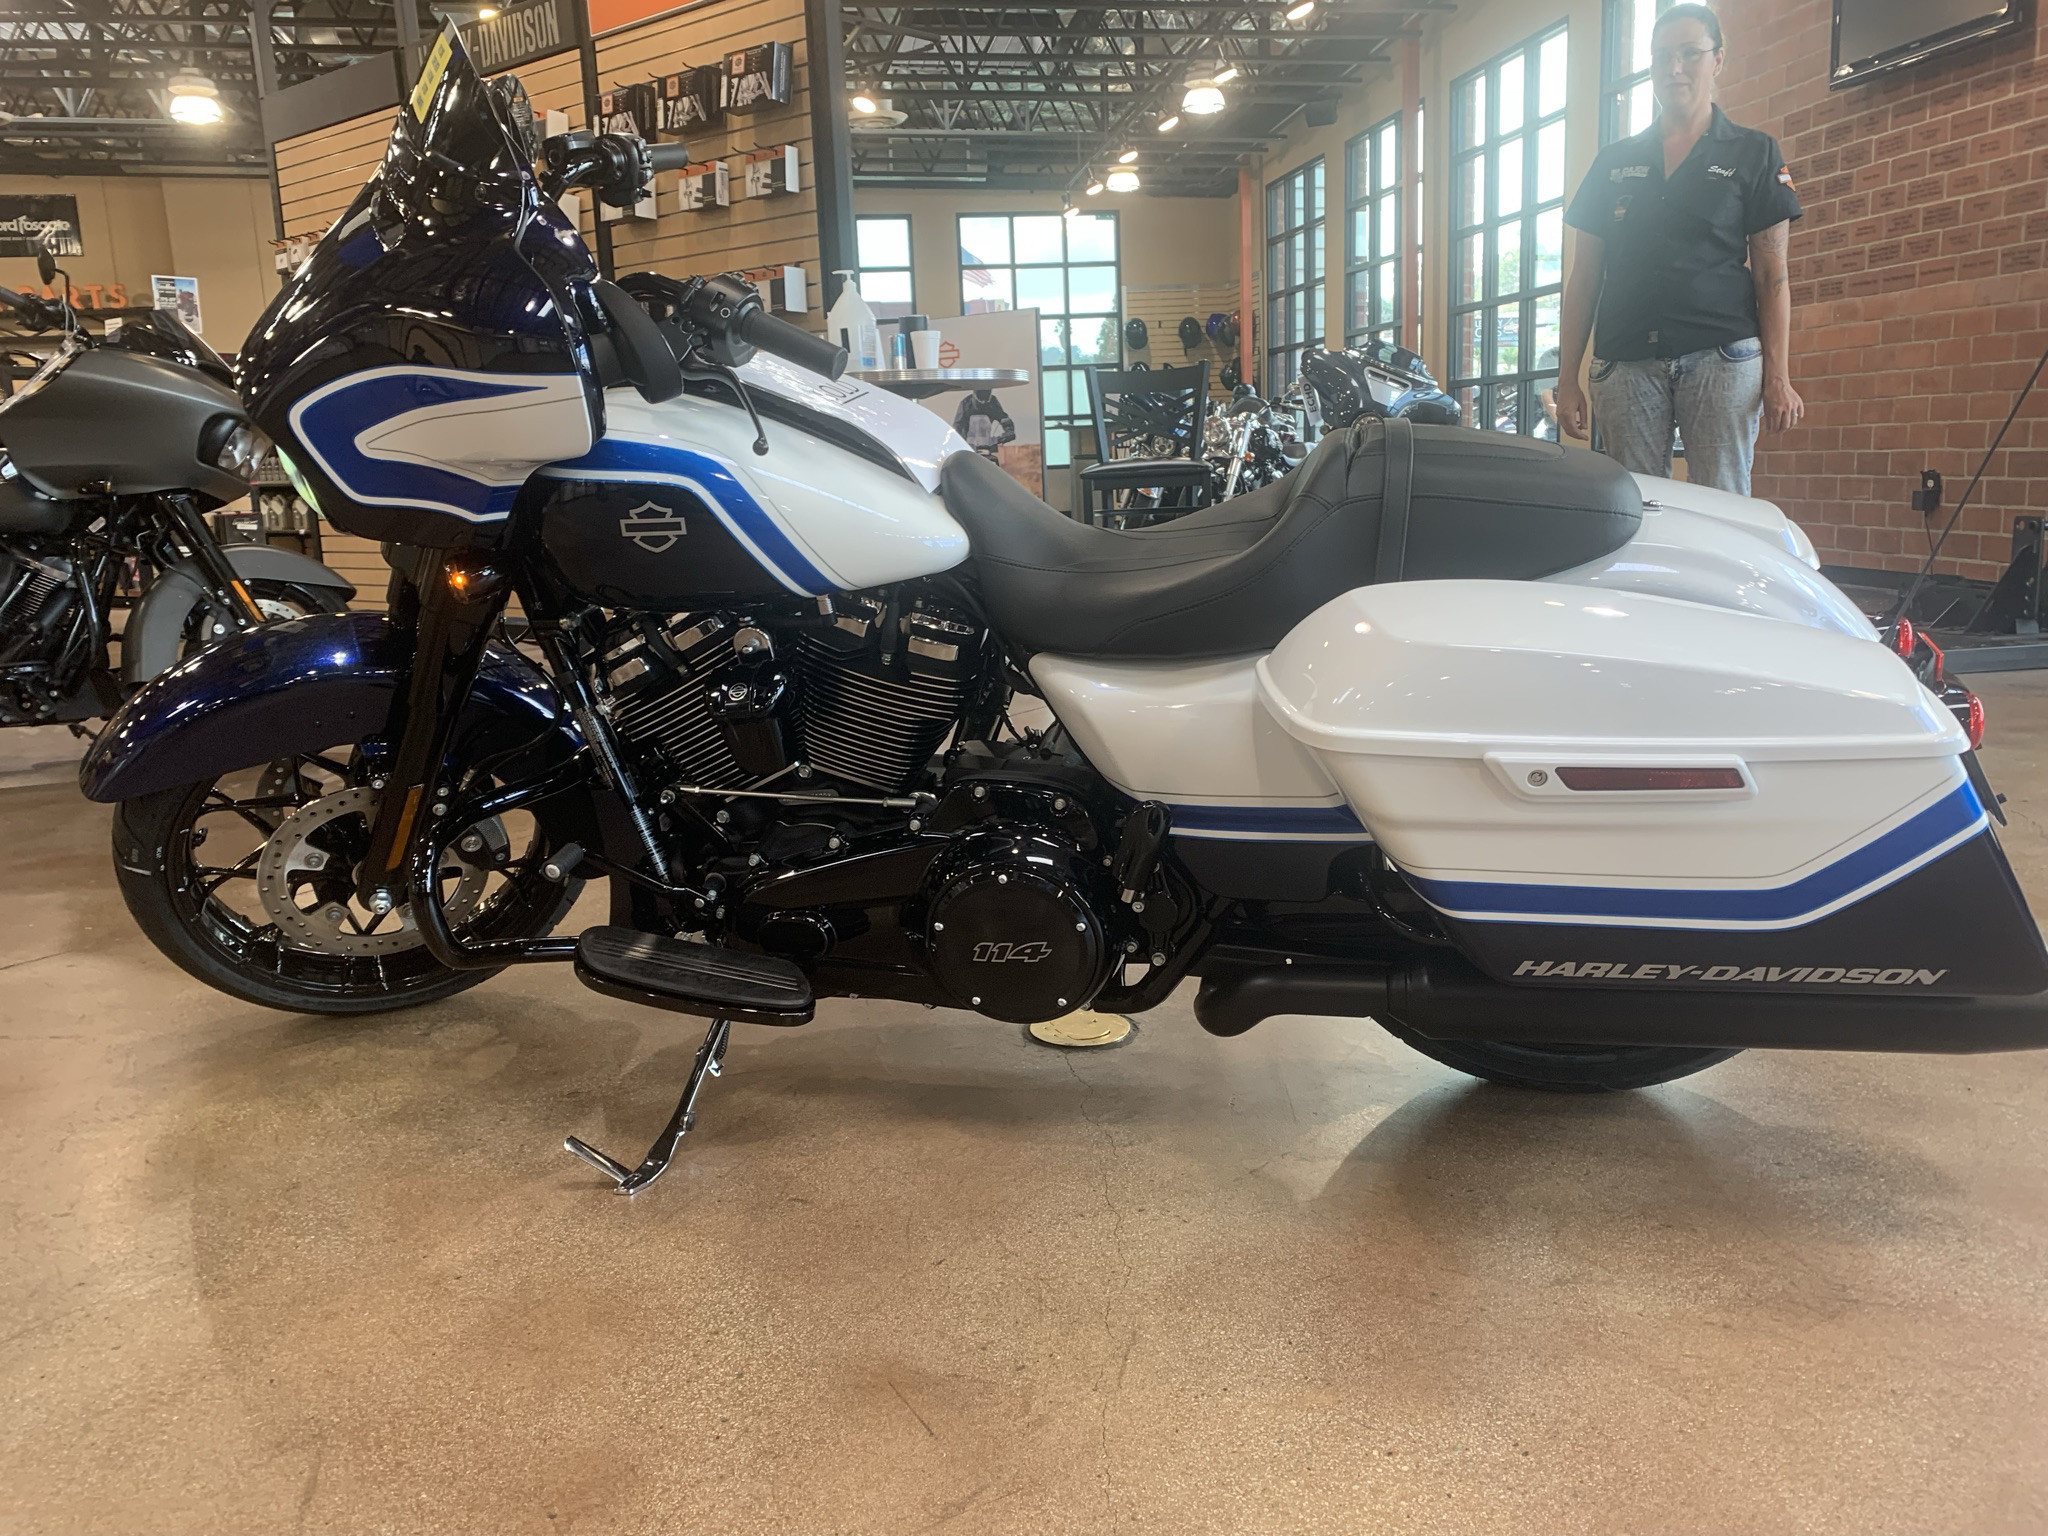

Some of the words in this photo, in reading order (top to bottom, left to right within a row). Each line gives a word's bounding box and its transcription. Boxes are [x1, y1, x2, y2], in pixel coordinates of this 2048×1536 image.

[1707, 165, 1737, 177] Staff
[1303, 383, 1317, 413] ECHD
[972, 941, 1053, 963] 114
[1512, 960, 1948, 985] HARLEY-DAVIDSON
